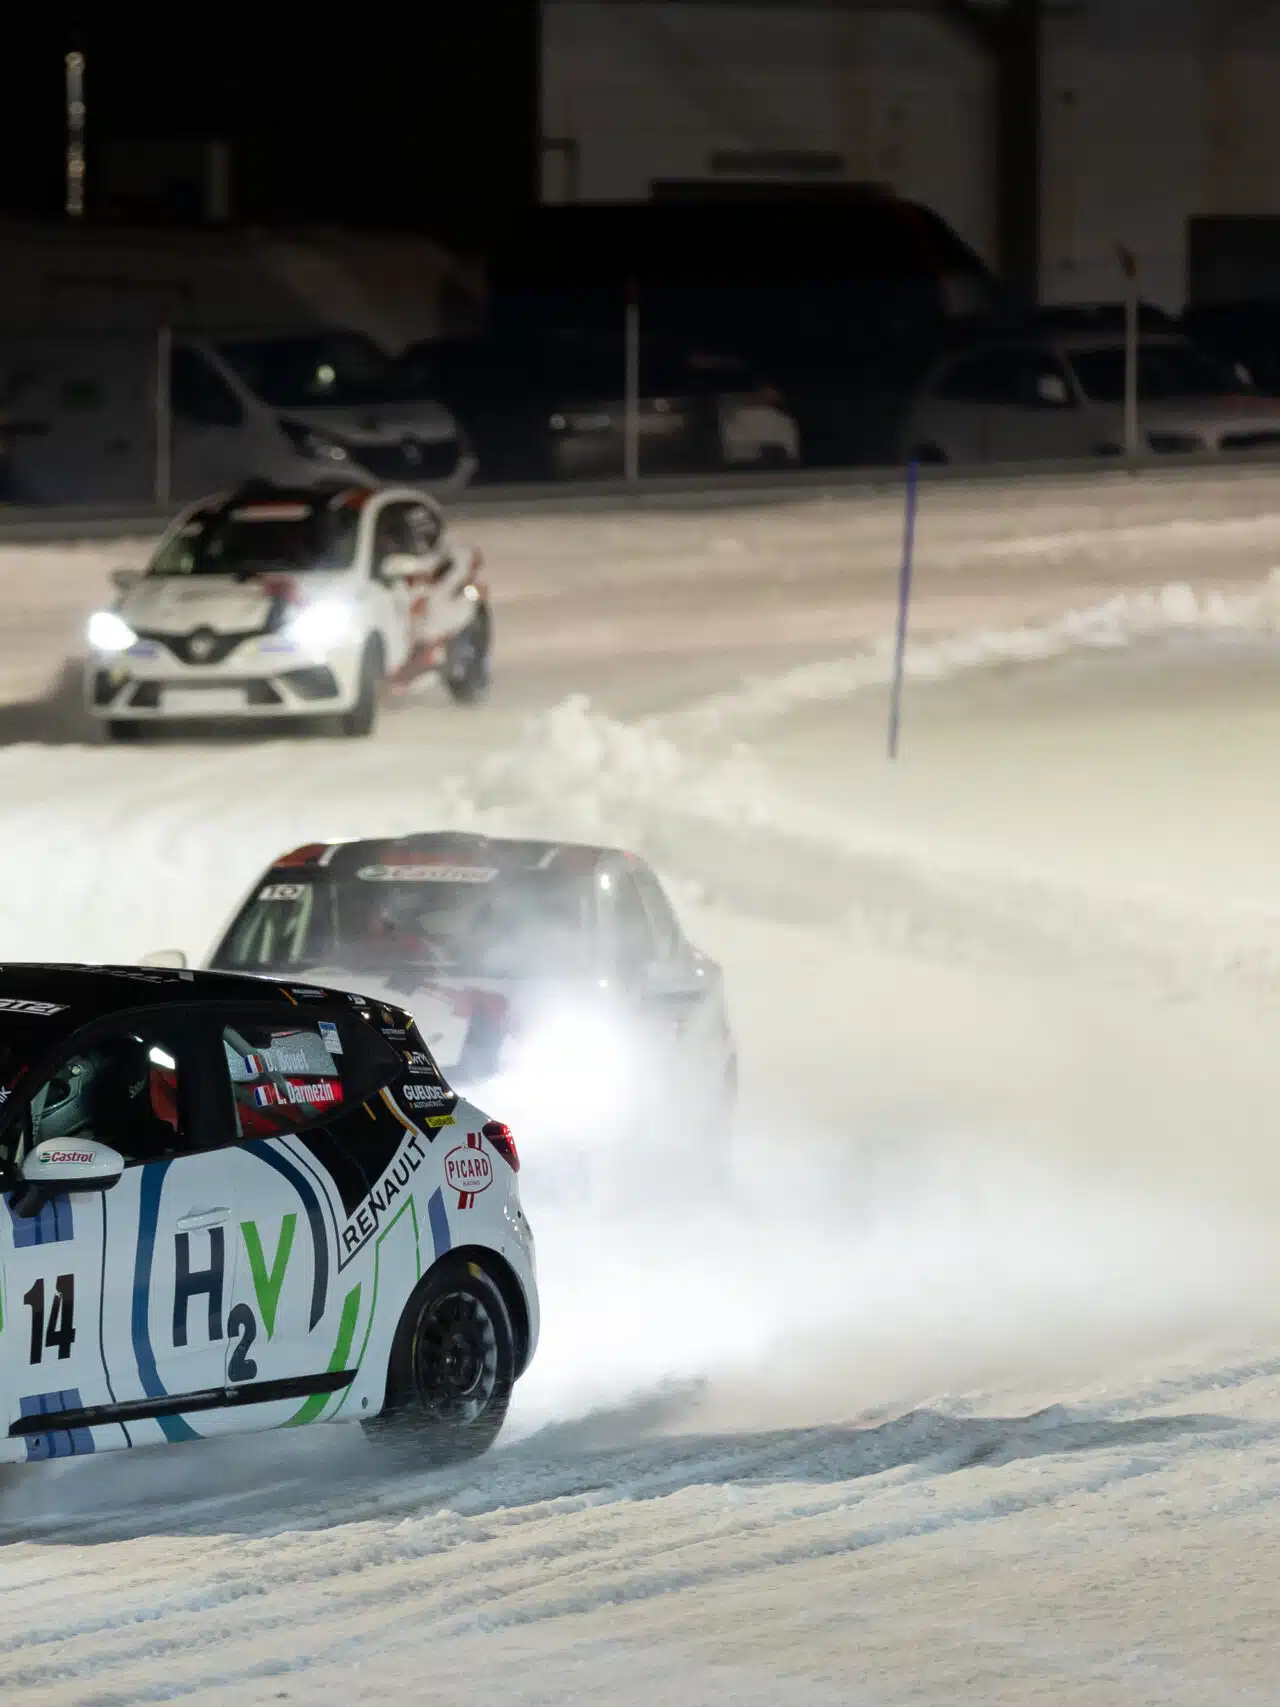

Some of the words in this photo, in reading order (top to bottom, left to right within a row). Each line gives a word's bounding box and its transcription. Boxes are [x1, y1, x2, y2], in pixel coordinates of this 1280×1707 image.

[285, 1077, 335, 1104] Darmezin
[403, 1085, 448, 1101] GUEUDET
[51, 1151, 93, 1163] Castrol
[448, 1158, 489, 1179] PICARD
[342, 1135, 426, 1253] RENAULT
[173, 1213, 297, 1382] H2V
[24, 1274, 76, 1365] 14
